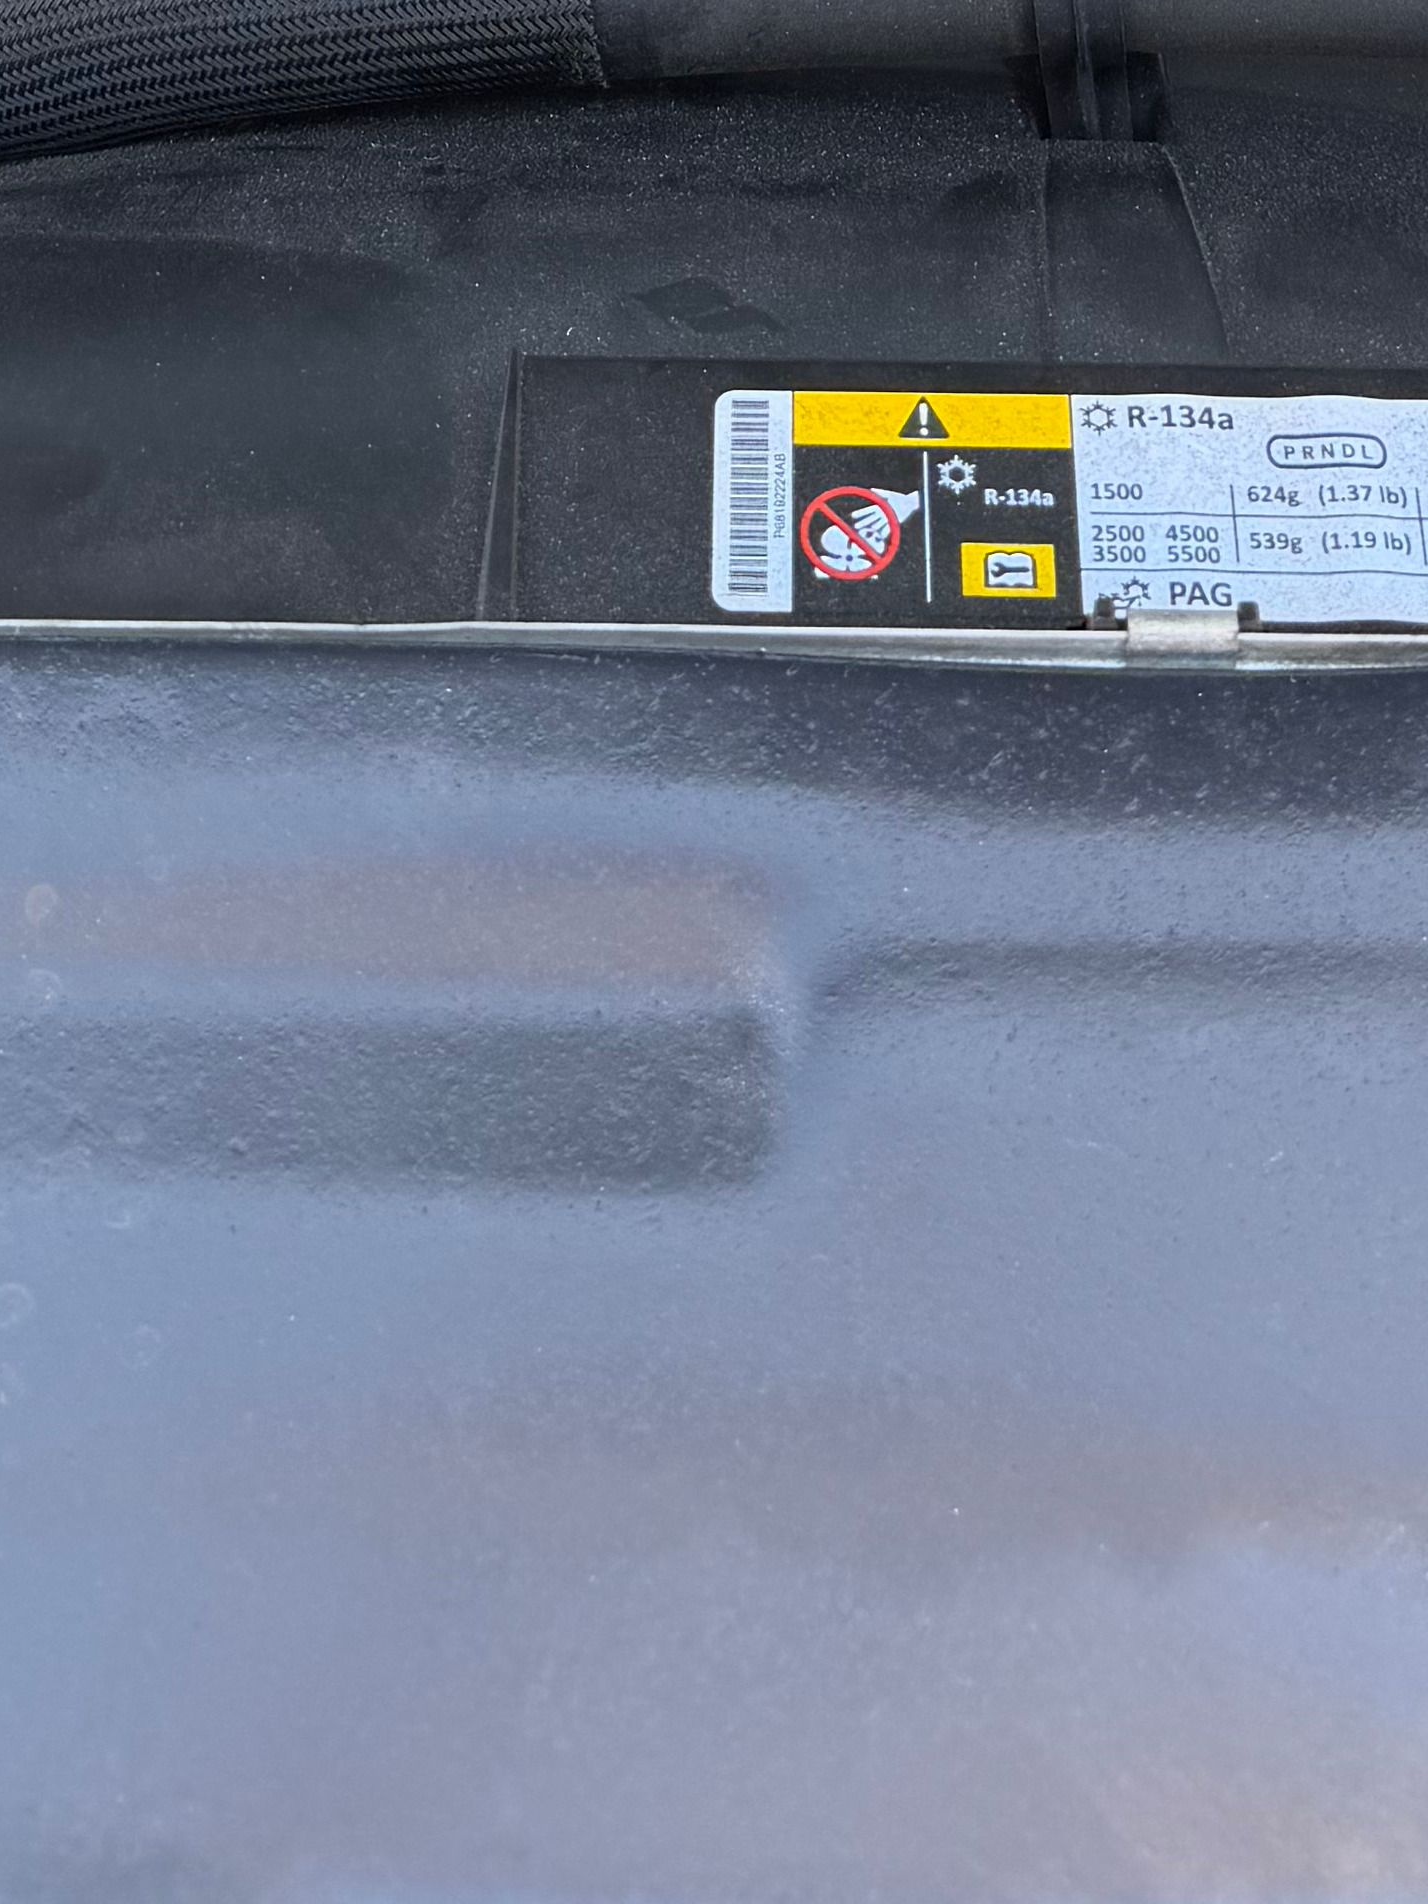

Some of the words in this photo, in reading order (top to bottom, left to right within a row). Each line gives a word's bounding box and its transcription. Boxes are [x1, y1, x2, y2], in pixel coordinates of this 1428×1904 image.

[1127, 404, 1235, 431] R-134a
[983, 487, 1055, 507] R-134a
[1090, 482, 1144, 501] 1500
[1247, 486, 1301, 507] 624g
[1319, 485, 1373, 507] (1.37
[1380, 486, 1408, 508] lb)
[1091, 525, 1146, 543] 2500
[1165, 525, 1220, 543] 4500
[1249, 532, 1304, 554] 539g
[1322, 531, 1377, 555] (1.19
[1384, 531, 1412, 555] lb)
[1092, 545, 1147, 563] 3500
[1167, 546, 1222, 564] 5500
[1168, 581, 1233, 607] PAG
